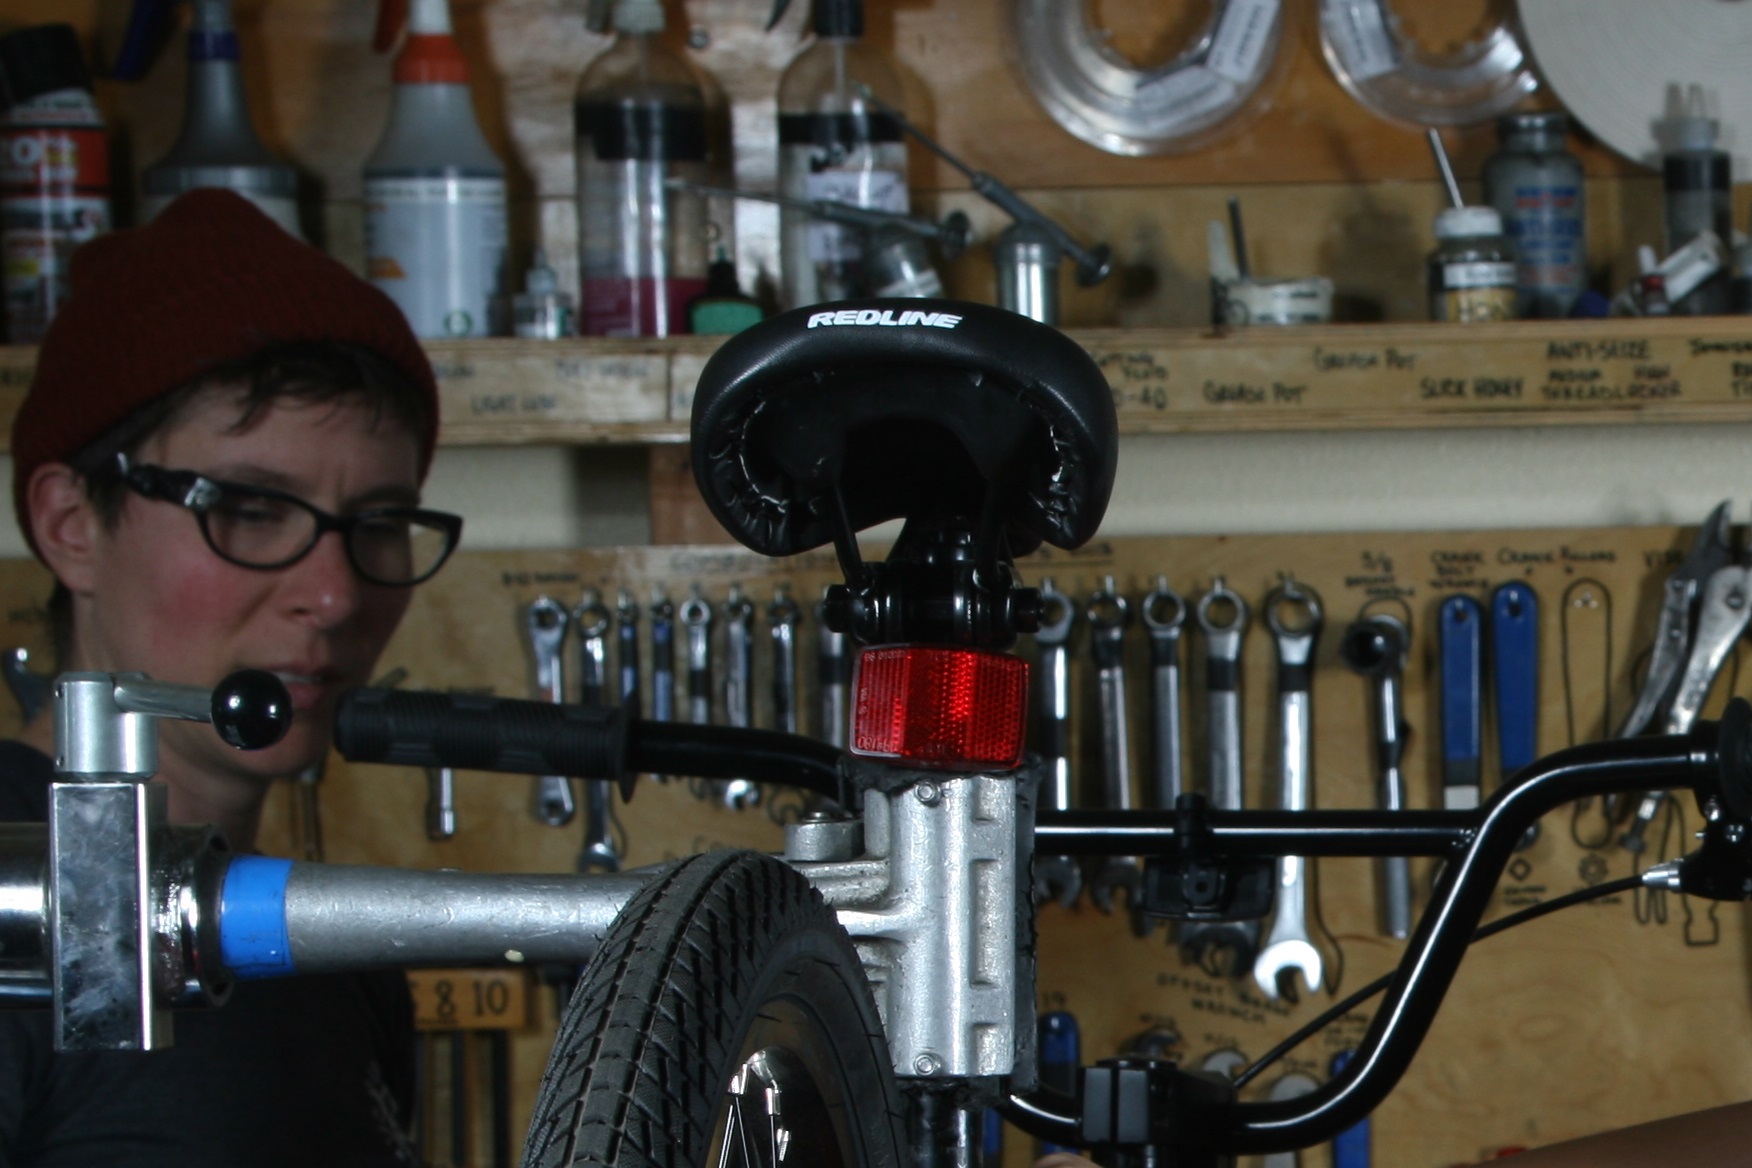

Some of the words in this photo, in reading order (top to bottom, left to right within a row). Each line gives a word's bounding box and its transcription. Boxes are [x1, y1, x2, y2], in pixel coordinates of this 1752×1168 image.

[807, 309, 963, 330] REDLINE
[1545, 340, 1650, 361] ANTI-SEIZE
[472, 979, 509, 1017] 10
